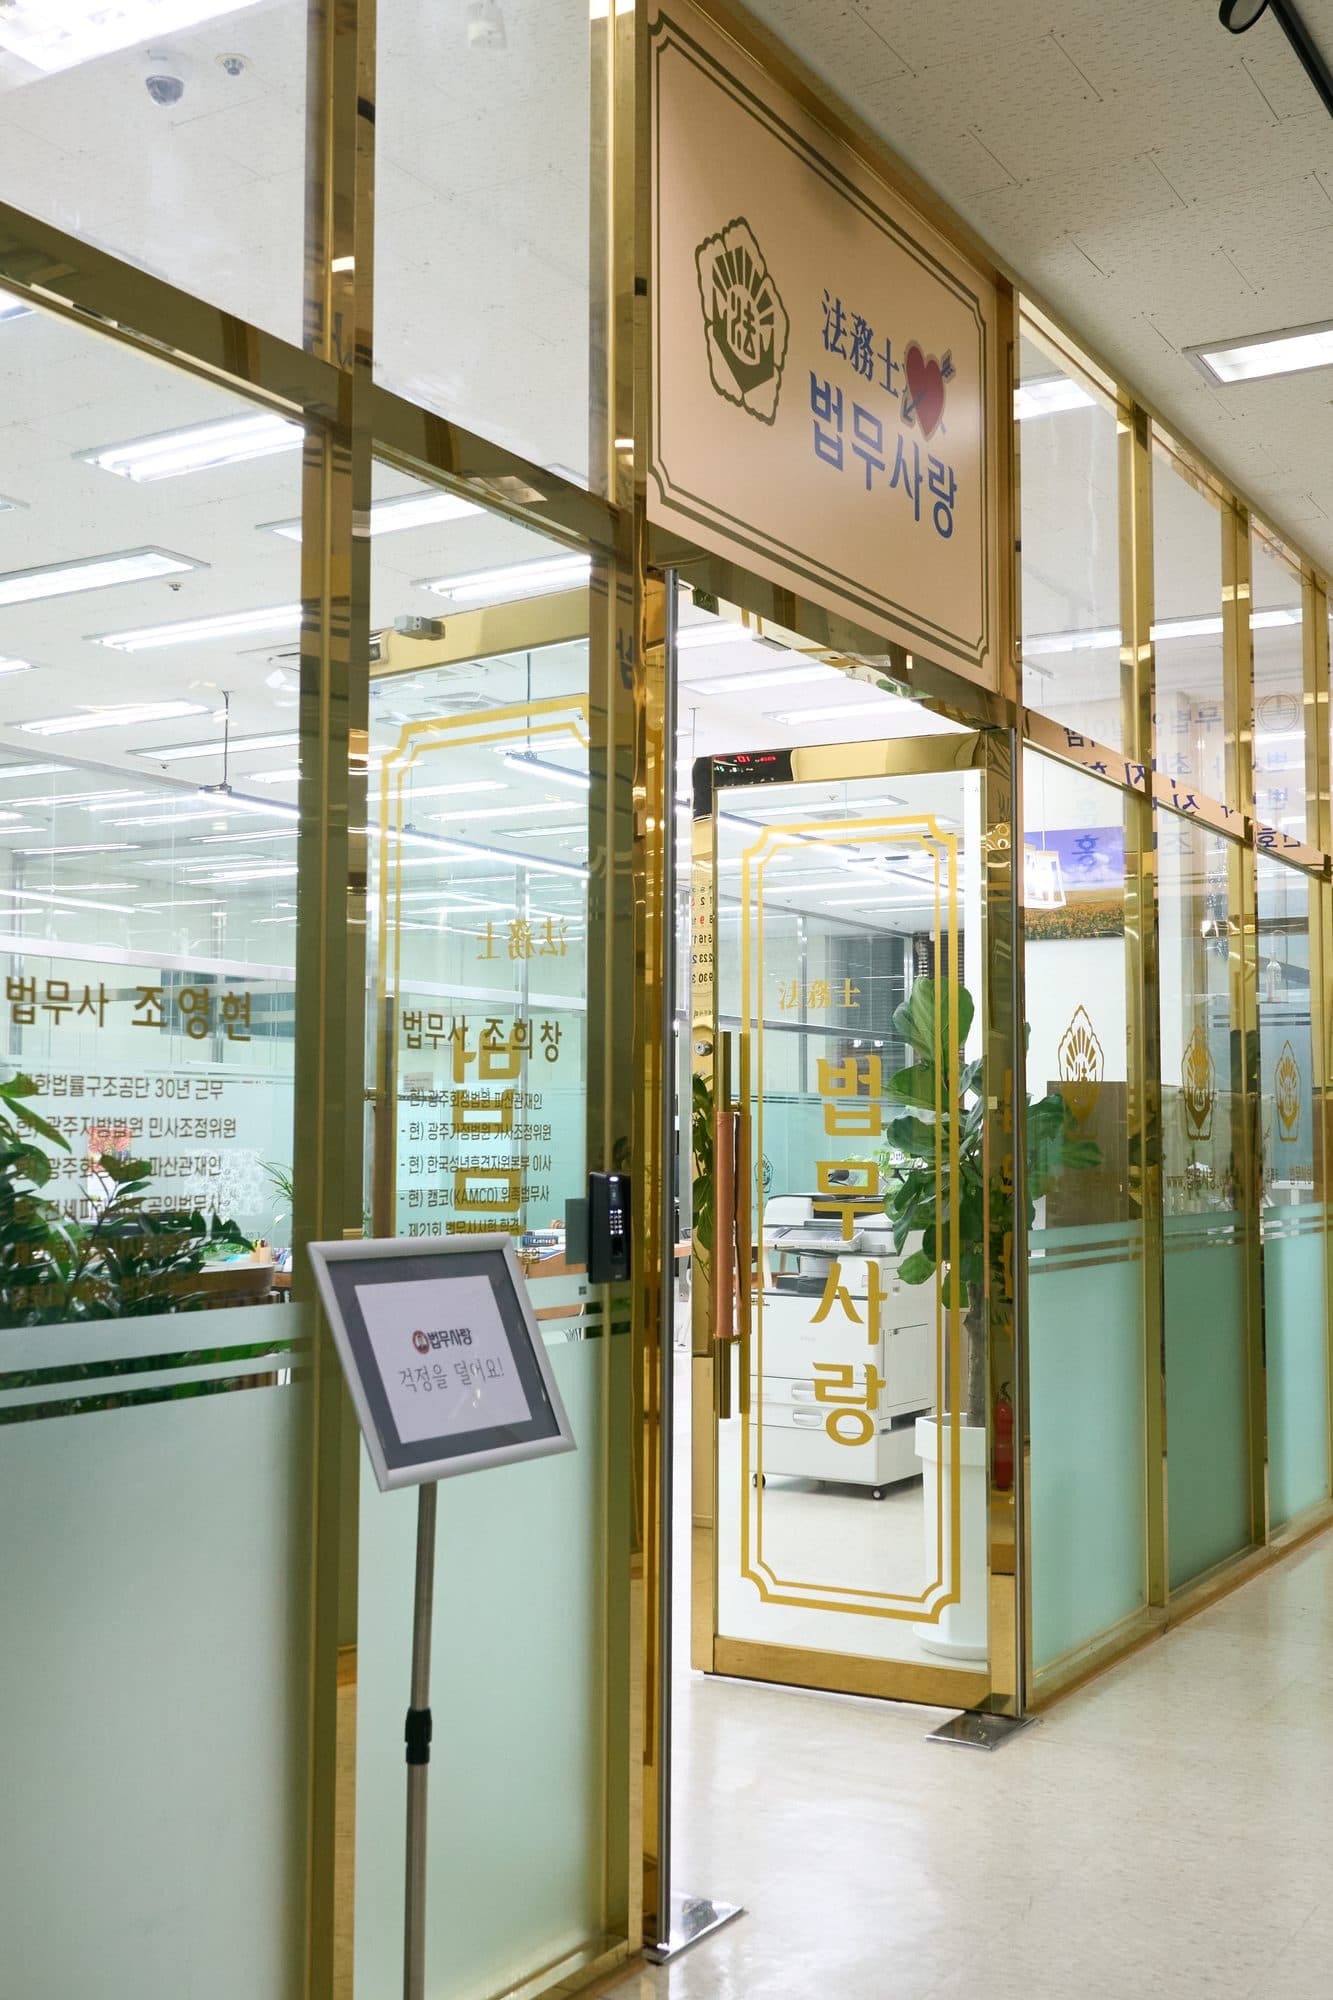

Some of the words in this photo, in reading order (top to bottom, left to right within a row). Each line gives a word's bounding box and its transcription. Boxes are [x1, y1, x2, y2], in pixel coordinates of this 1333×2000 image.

[821, 288, 900, 399] 法務士
[809, 370, 957, 538] 법무사랑
[5, 976, 109, 1028] 법무사
[132, 984, 252, 1042] 조영현
[778, 977, 861, 1010] 法務士
[402, 1011, 468, 1050] 법무사
[482, 1017, 562, 1063] 조희창
[155, 1078, 190, 1100] 30년
[195, 1079, 224, 1100] 근무
[149, 1117, 237, 1138] 민사조정위원
[408, 1155, 424, 1174] 현)
[532, 1153, 552, 1172] 이사
[408, 1189, 423, 1208] 현)
[427, 1187, 498, 1208] 캠코(KAMCO)
[809, 1055, 888, 1447] 법무사랑
[427, 1327, 473, 1349] 법무사랑
[398, 1364, 448, 1392] 걱정을
[454, 1357, 505, 1386] 덜어요!
